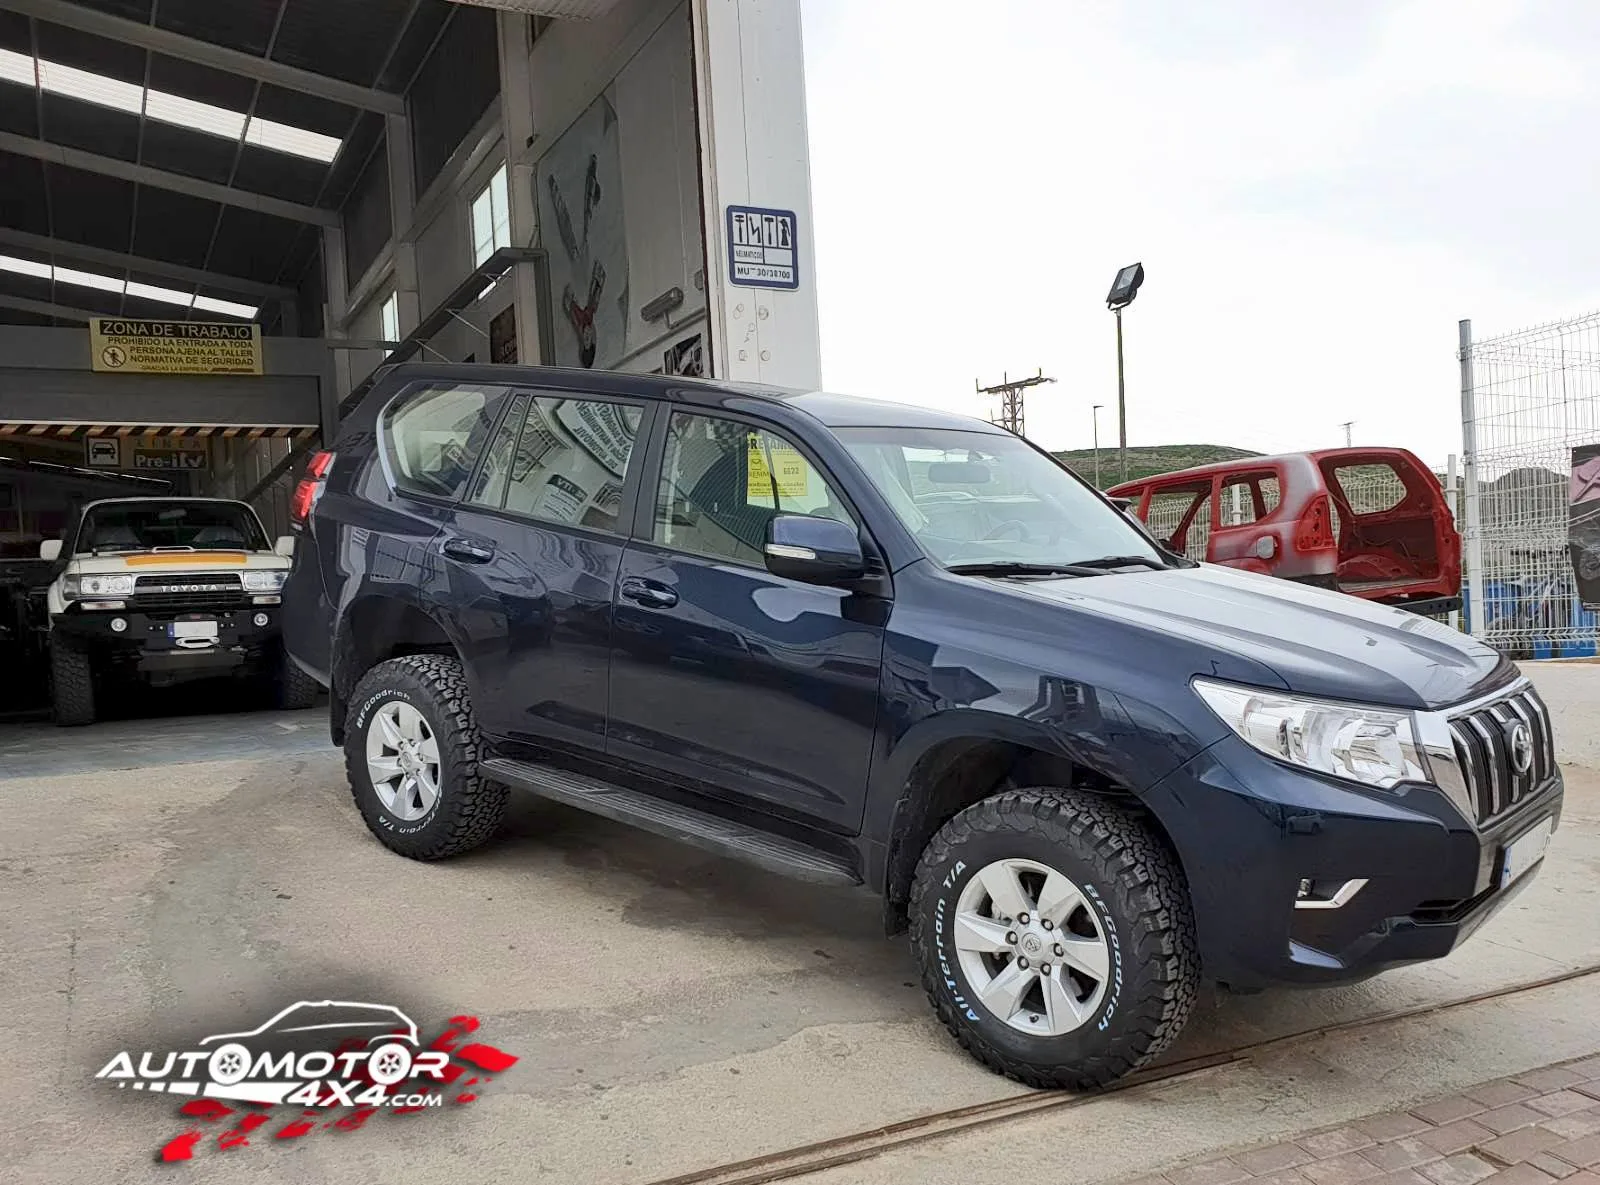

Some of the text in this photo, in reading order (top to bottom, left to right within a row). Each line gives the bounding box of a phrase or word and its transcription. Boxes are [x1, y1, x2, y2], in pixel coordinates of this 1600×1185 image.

[102, 322, 250, 338] ZONA DE TRABAJO
[108, 337, 160, 346] PROHIBIDO
[163, 338, 174, 346] LA
[177, 338, 219, 347] ENTRADA
[230, 340, 253, 348] TODA
[130, 346, 253, 357] PERSONA AJENA AL TALLER
[130, 355, 184, 364] NORMATIVA
[201, 357, 254, 366] SEGURIDAD
[356, 689, 410, 729] BFGoodrich
[379, 816, 394, 830] T/A
[935, 860, 980, 1022] All-Terrain T/A
[1084, 884, 1123, 1031] BFGoodrich
